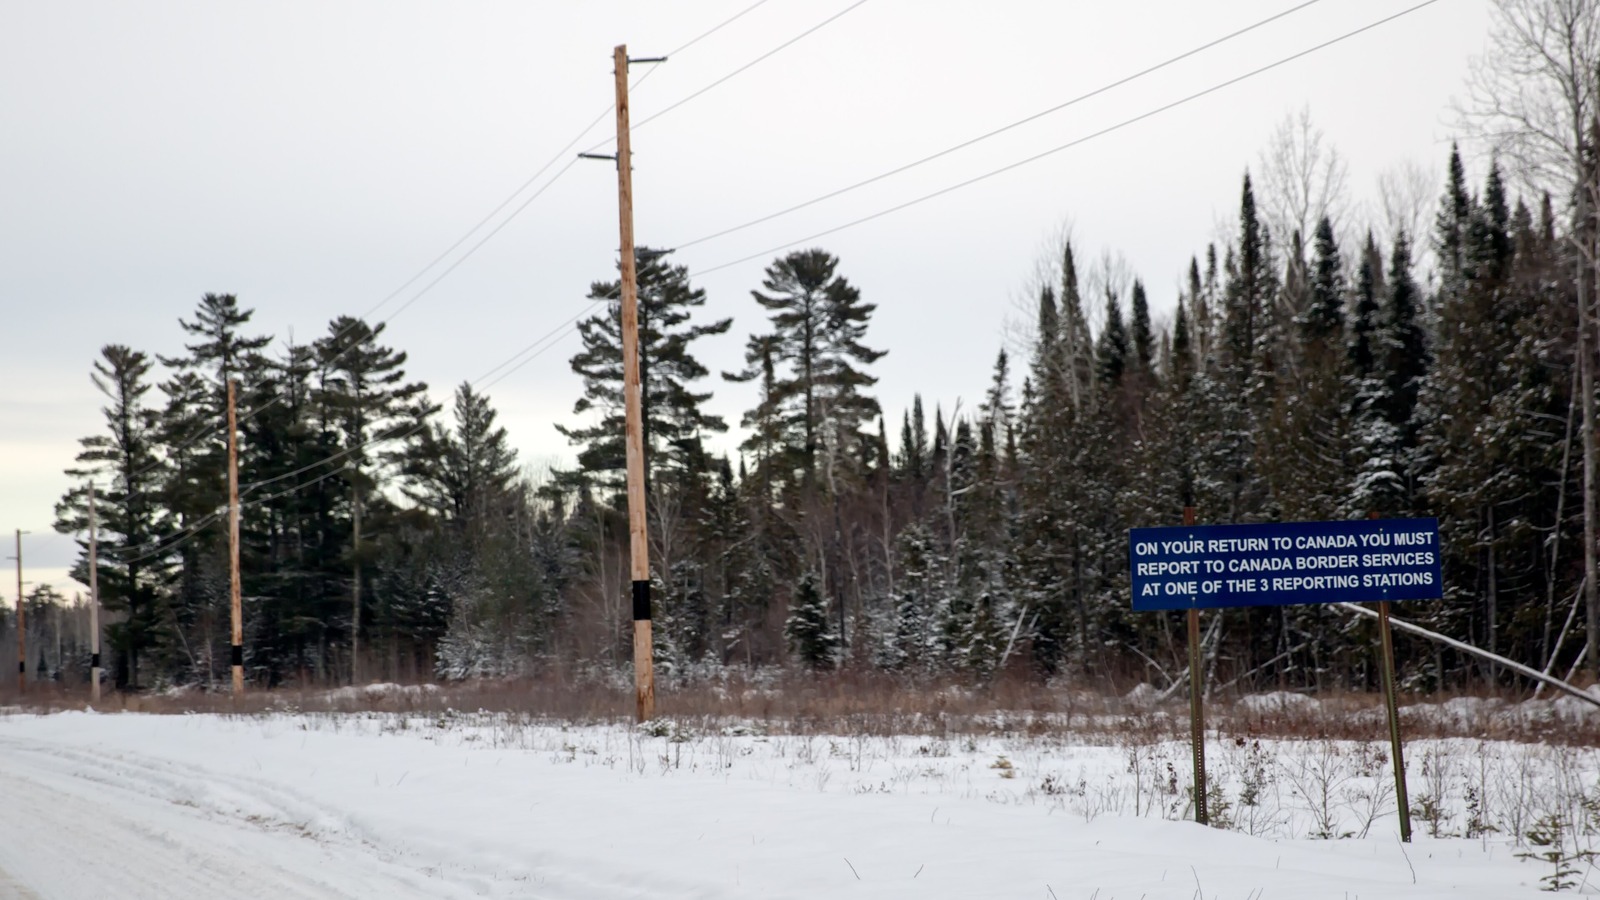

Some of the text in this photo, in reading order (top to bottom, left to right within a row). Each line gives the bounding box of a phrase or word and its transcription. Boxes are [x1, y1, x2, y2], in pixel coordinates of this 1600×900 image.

[1136, 532, 1433, 555] ON YOUR RETURN TO CANADA YOU MUST
[1138, 552, 1434, 575] REPORT TO CANADA BORDER SERVICES
[1142, 572, 1433, 596] AT ONE OF THE 3 REPORTING STATIONS
